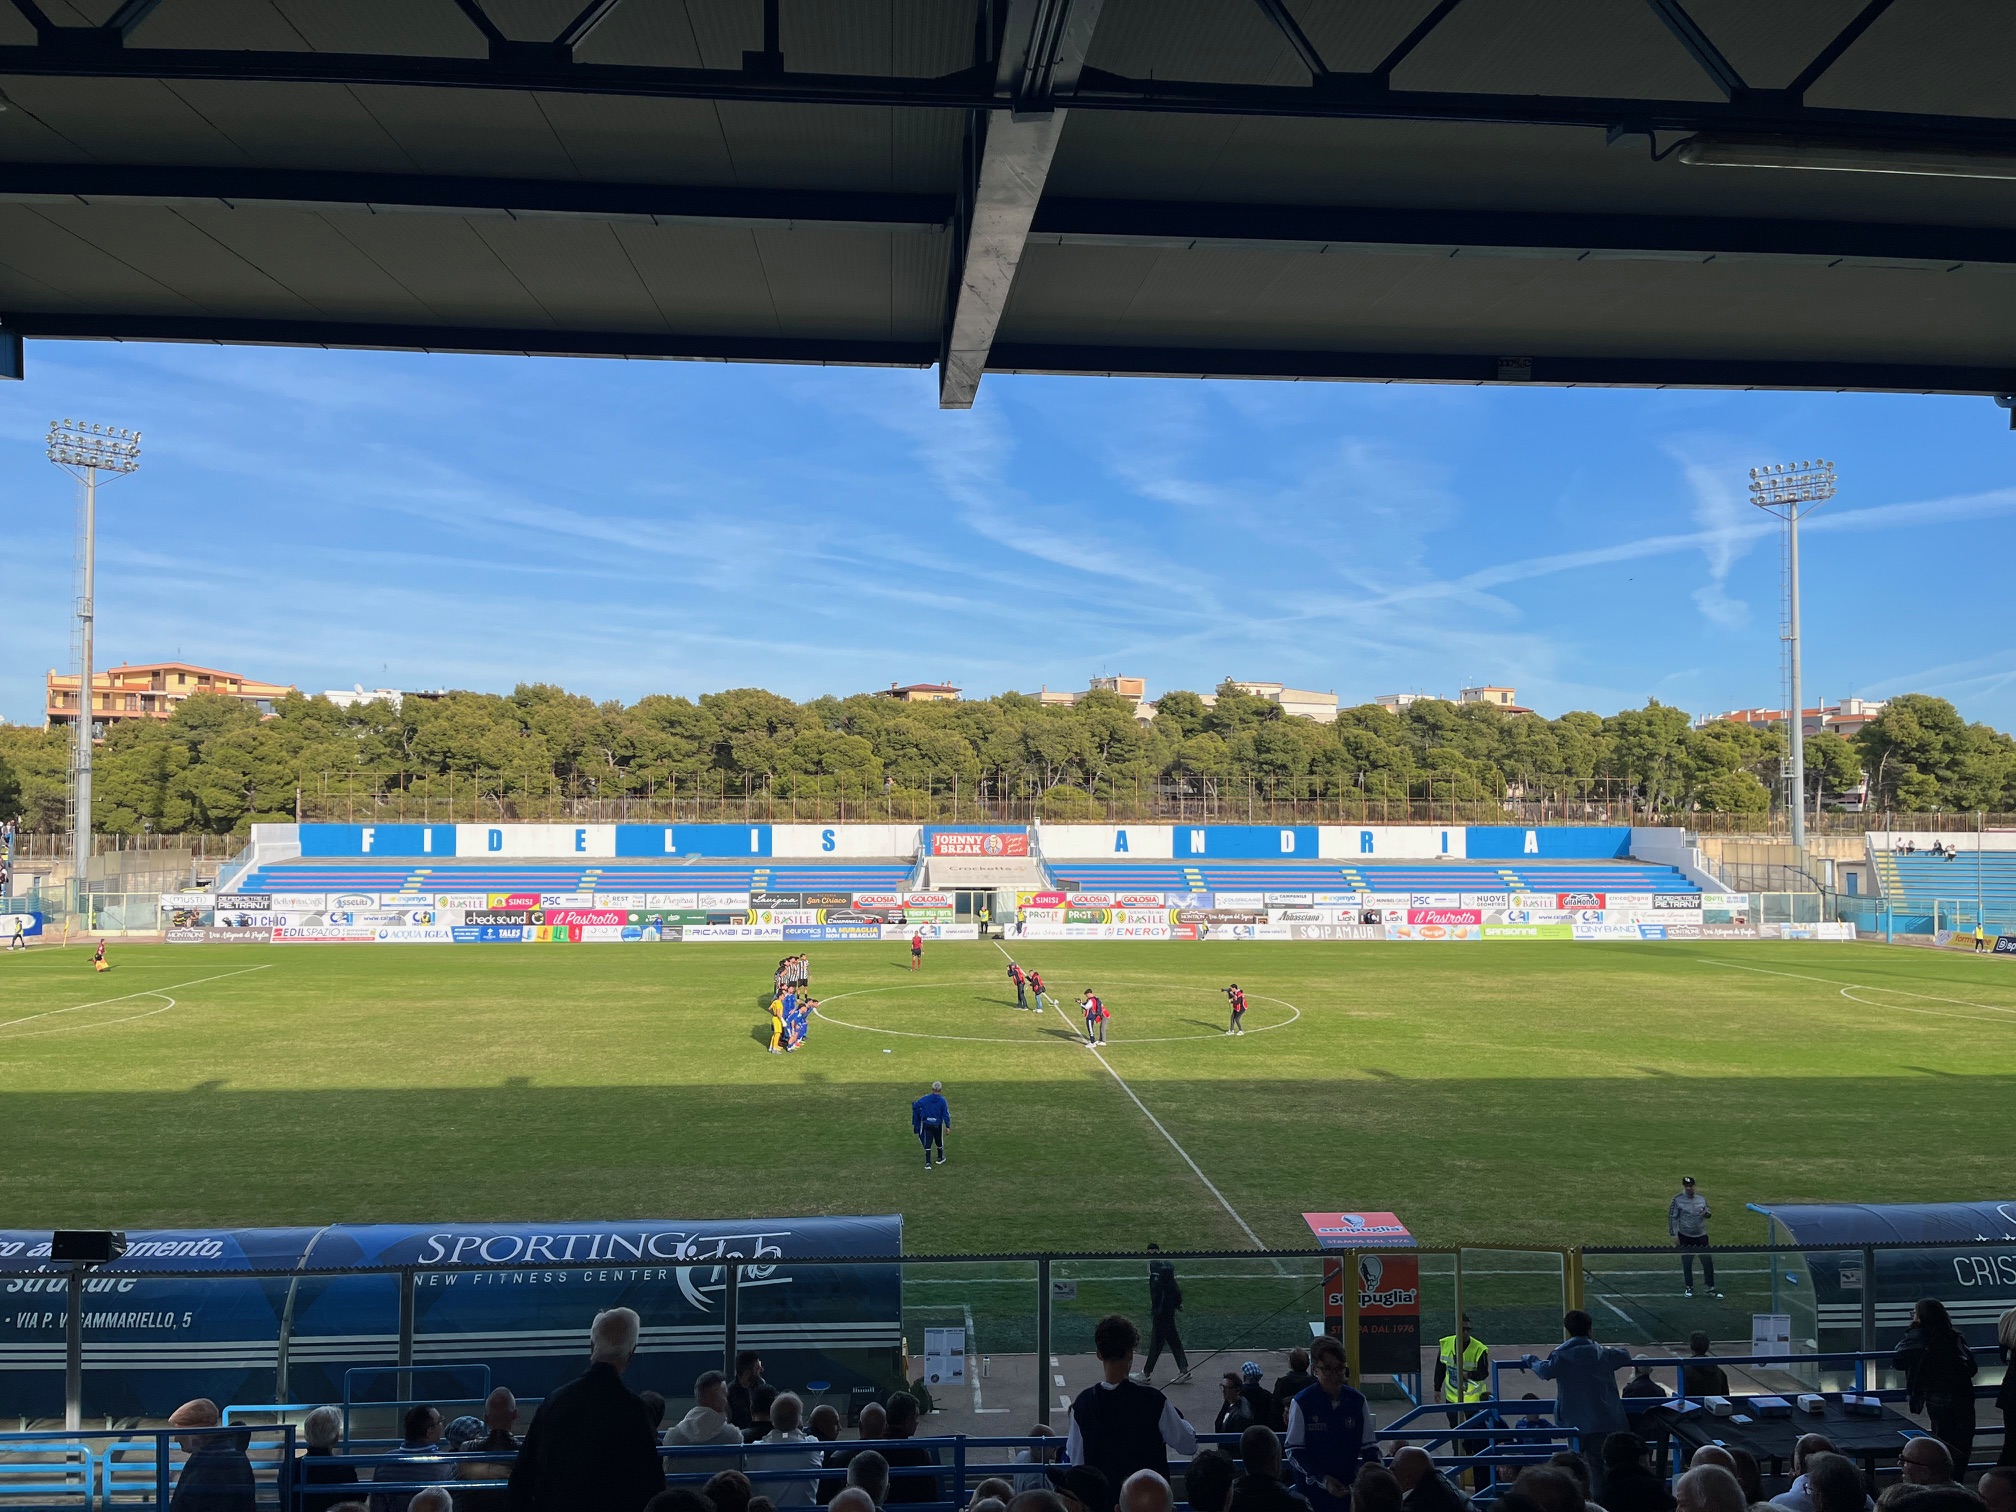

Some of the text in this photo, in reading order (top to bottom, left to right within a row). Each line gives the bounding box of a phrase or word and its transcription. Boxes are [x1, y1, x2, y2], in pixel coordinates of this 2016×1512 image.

[935, 836, 983, 846] JOHNNY
[940, 845, 981, 854] BREAK
[449, 900, 483, 908] BASILE
[542, 896, 560, 905] PSC
[806, 897, 820, 905] San
[821, 896, 847, 904] Ciriaco
[1413, 896, 1430, 905] PSC
[1523, 900, 1554, 908] BASILE
[261, 916, 286, 926] CHIO
[553, 911, 619, 925] il Pastrotto
[773, 915, 812, 924] BASILE
[1128, 915, 1164, 923] BASILE
[1414, 910, 1475, 924] il Pastrotto
[390, 930, 421, 938] ACQUA
[424, 930, 449, 938] IGEA
[498, 928, 521, 938] TALES
[788, 927, 822, 935] euronics
[1116, 928, 1168, 936] ENERGY
[417, 1232, 687, 1264] SPORTING
[1953, 1256, 2016, 1288] CRIS
[413, 1269, 668, 1286] NEW FITNESS CENTER
[16, 1312, 38, 1328] VIA
[42, 1312, 53, 1328] P.
[81, 1312, 177, 1330] AMMARIELLO,
[182, 1312, 193, 1328] 5
[1332, 1324, 1415, 1334] STPA DAL 1976
